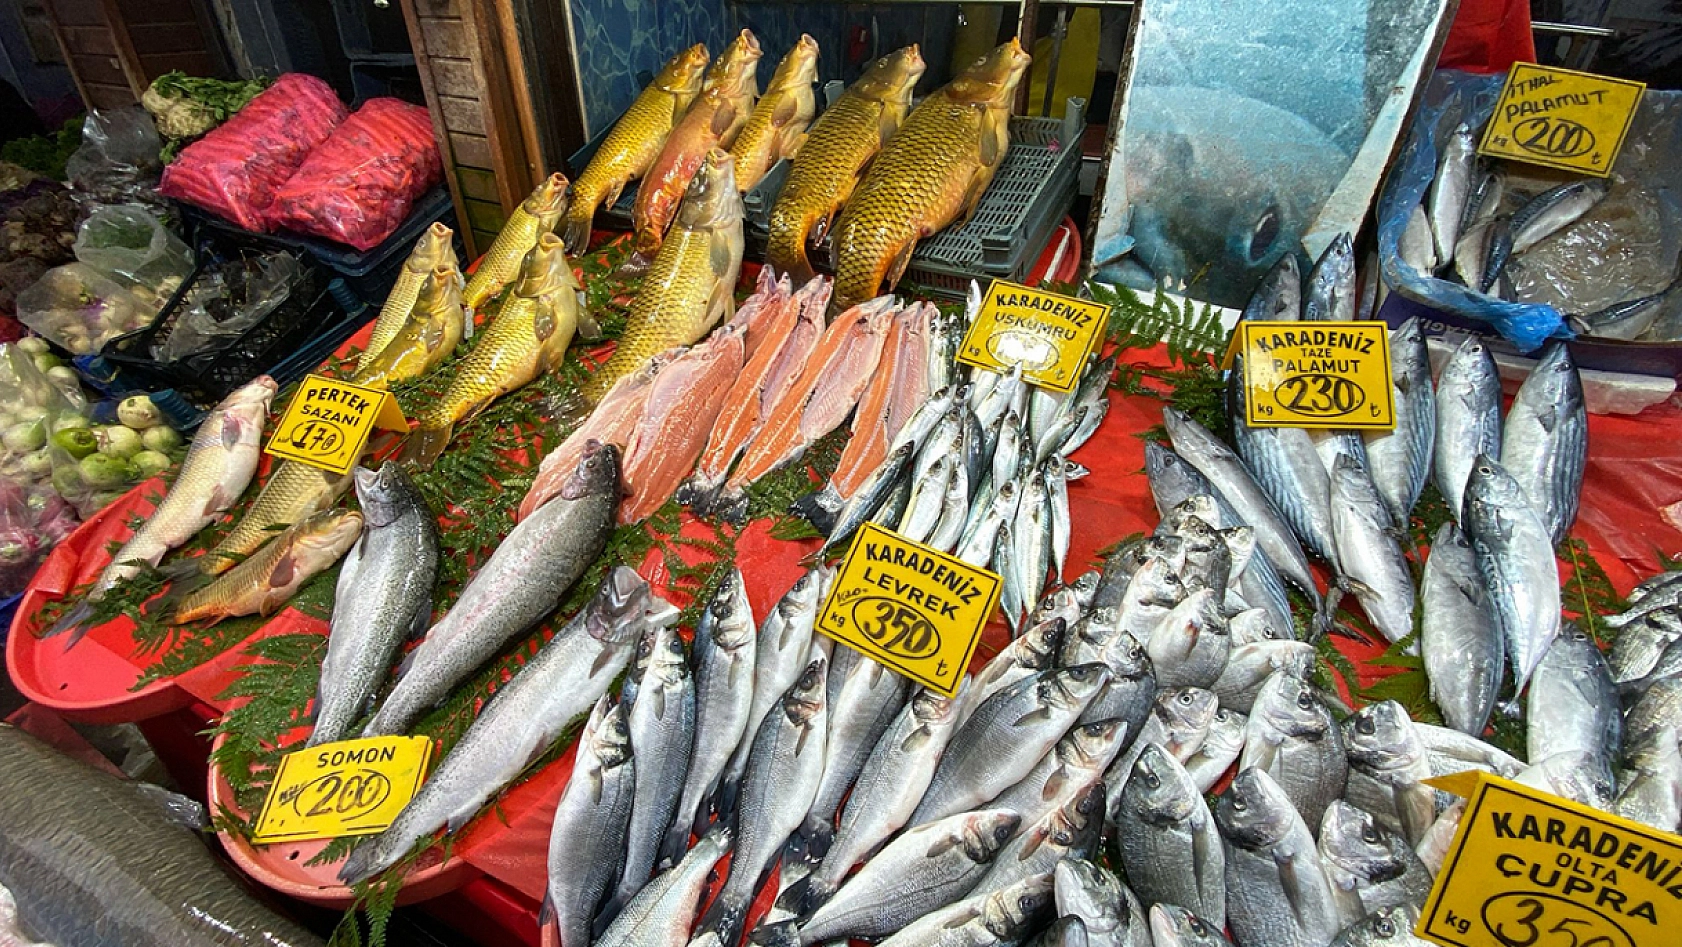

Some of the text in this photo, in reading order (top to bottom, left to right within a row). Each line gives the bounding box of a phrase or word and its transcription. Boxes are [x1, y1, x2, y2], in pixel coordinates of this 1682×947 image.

[1507, 90, 1610, 123] PALAMUT
[996, 293, 1092, 328] KARADENİZ
[994, 311, 1077, 341] USKUMRU
[1252, 330, 1375, 355] KARADENİZ
[1301, 347, 1332, 358] TAZE
[1272, 359, 1361, 374] PALAMUT
[306, 387, 370, 414] PERTEK
[1257, 402, 1273, 416] kg
[300, 404, 361, 428] SAZANI
[865, 543, 983, 606] KARADENİZ
[863, 566, 961, 621] LEVREK
[829, 611, 847, 628] kg
[316, 746, 396, 768] SOMON
[305, 774, 381, 818] 200
[1556, 852, 1618, 885] OLTA
[1444, 898, 1615, 947] kg 35
